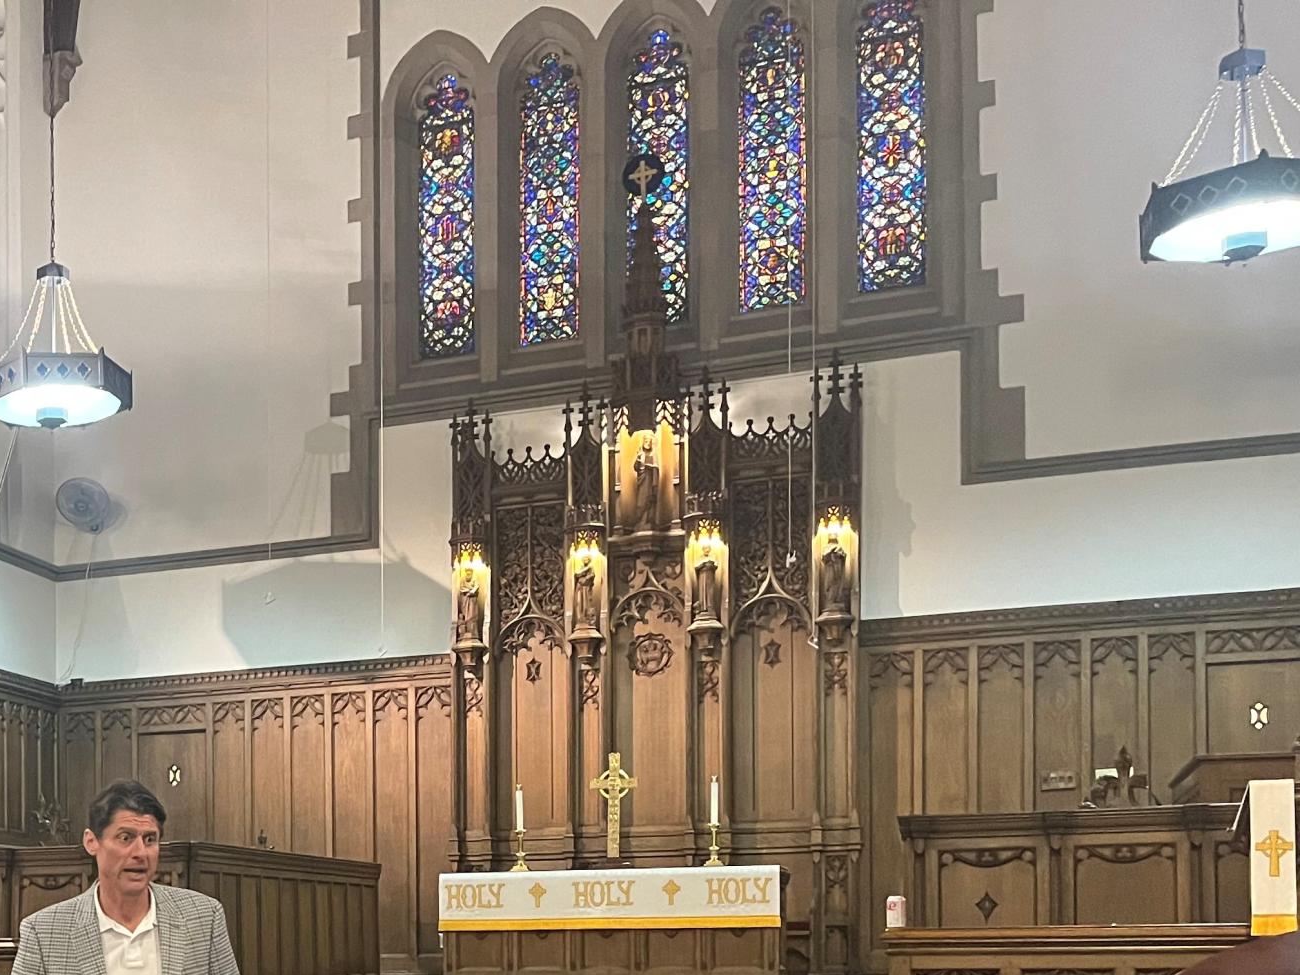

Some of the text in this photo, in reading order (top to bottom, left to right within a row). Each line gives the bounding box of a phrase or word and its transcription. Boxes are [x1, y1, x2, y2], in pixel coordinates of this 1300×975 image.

[445, 877, 773, 909] HOLY HOLY HOLY
